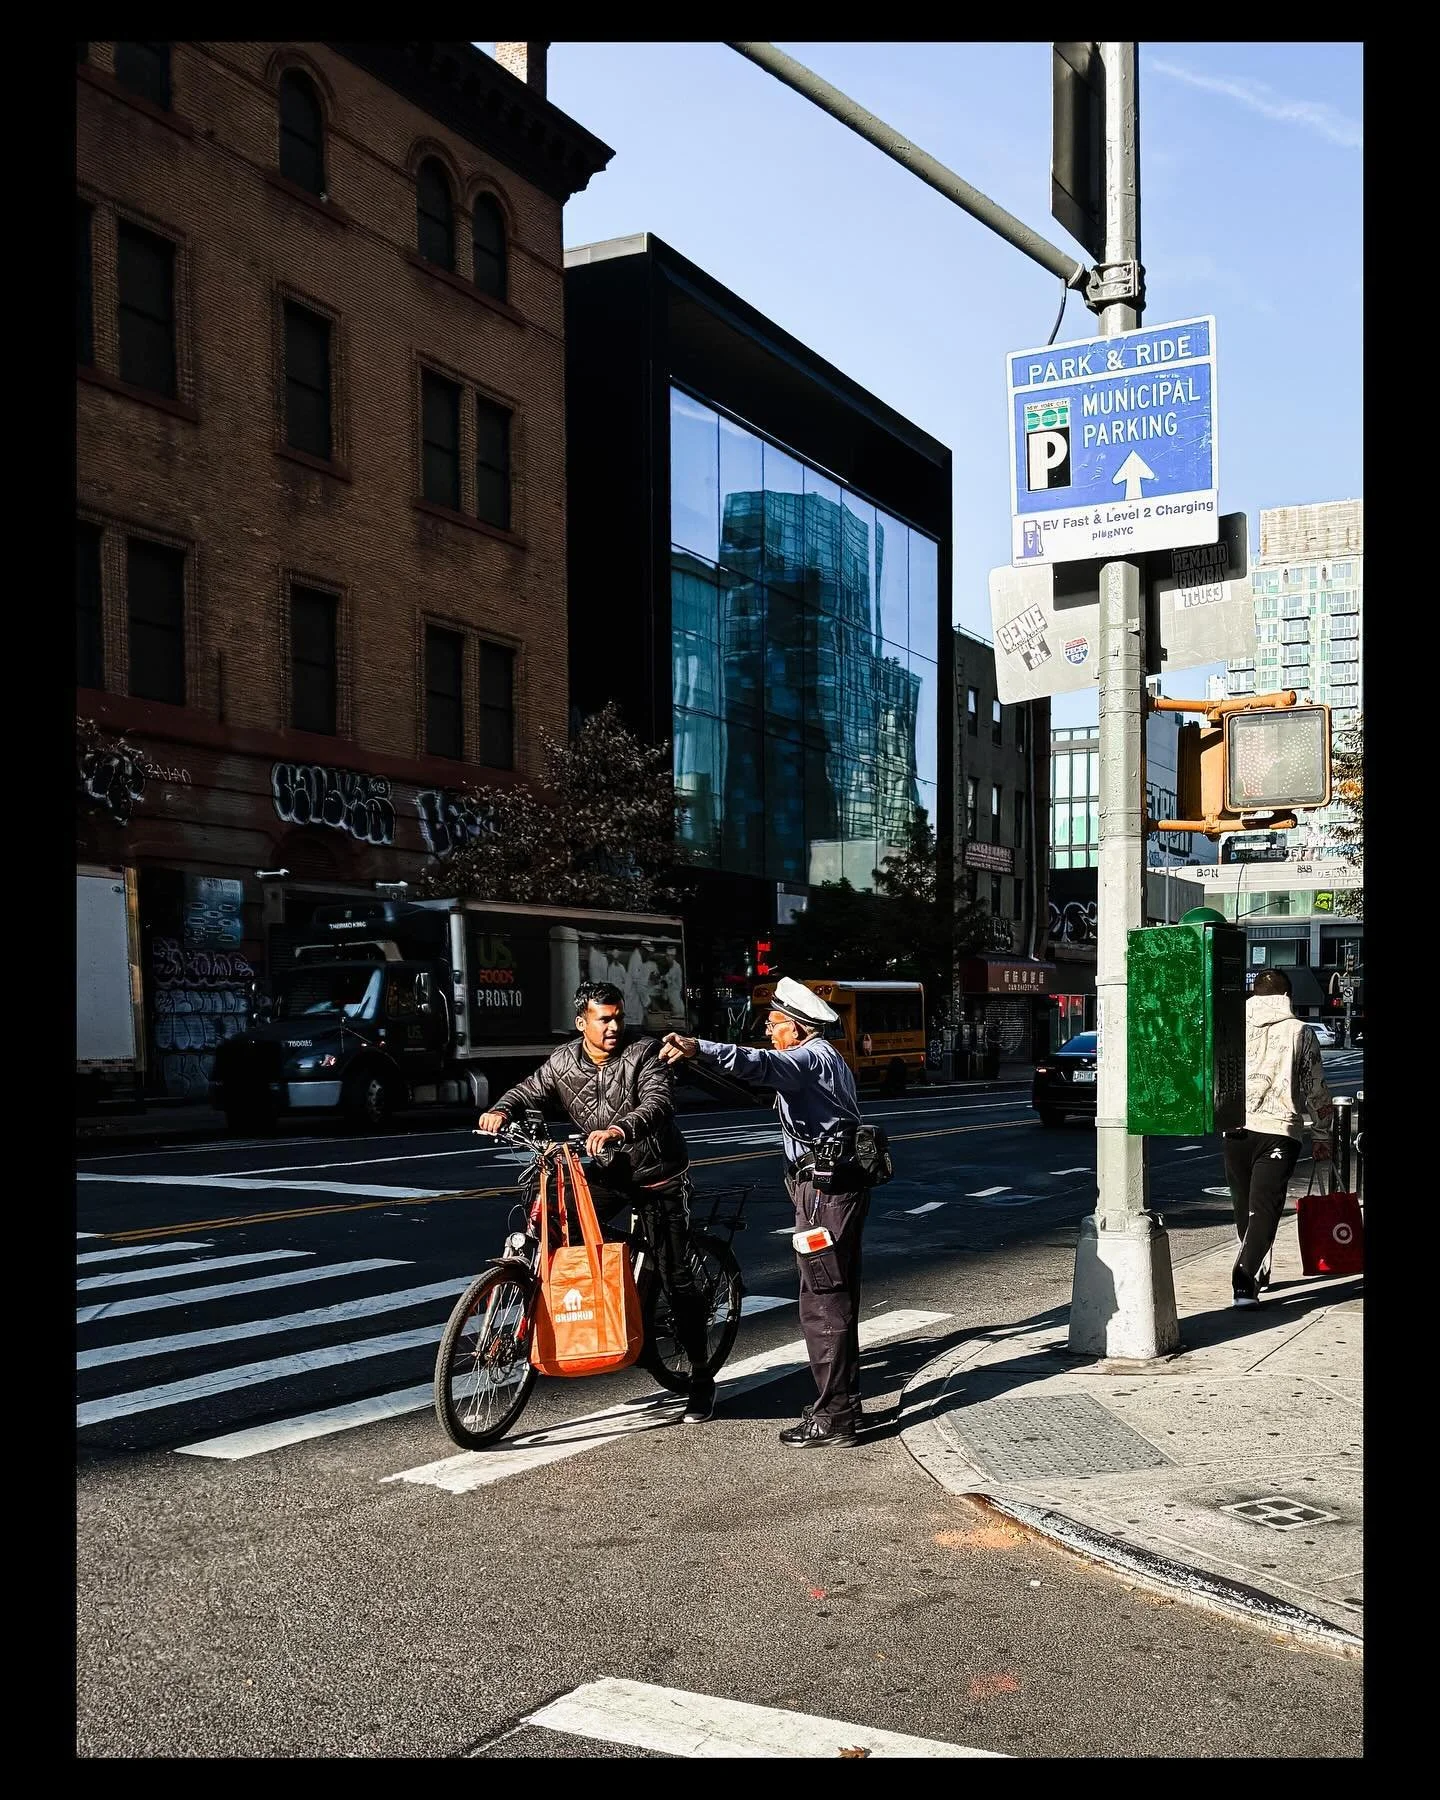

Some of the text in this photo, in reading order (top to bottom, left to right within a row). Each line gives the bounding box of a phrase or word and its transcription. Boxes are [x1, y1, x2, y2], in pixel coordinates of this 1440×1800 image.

[1028, 335, 1192, 385] PARK & RIDE
[1082, 377, 1201, 417] MUNICIPAL
[1027, 407, 1069, 430] DOT
[1083, 411, 1178, 449] PARKING
[1029, 431, 1068, 490] P
[1043, 500, 1214, 531] EV Fast & Level 2 Charging
[1091, 526, 1134, 541] plugNYC
[997, 606, 1047, 651] GENIE
[1196, 868, 1219, 878] BON
[479, 968, 515, 985] FOODS
[477, 989, 522, 1008] PRONTO
